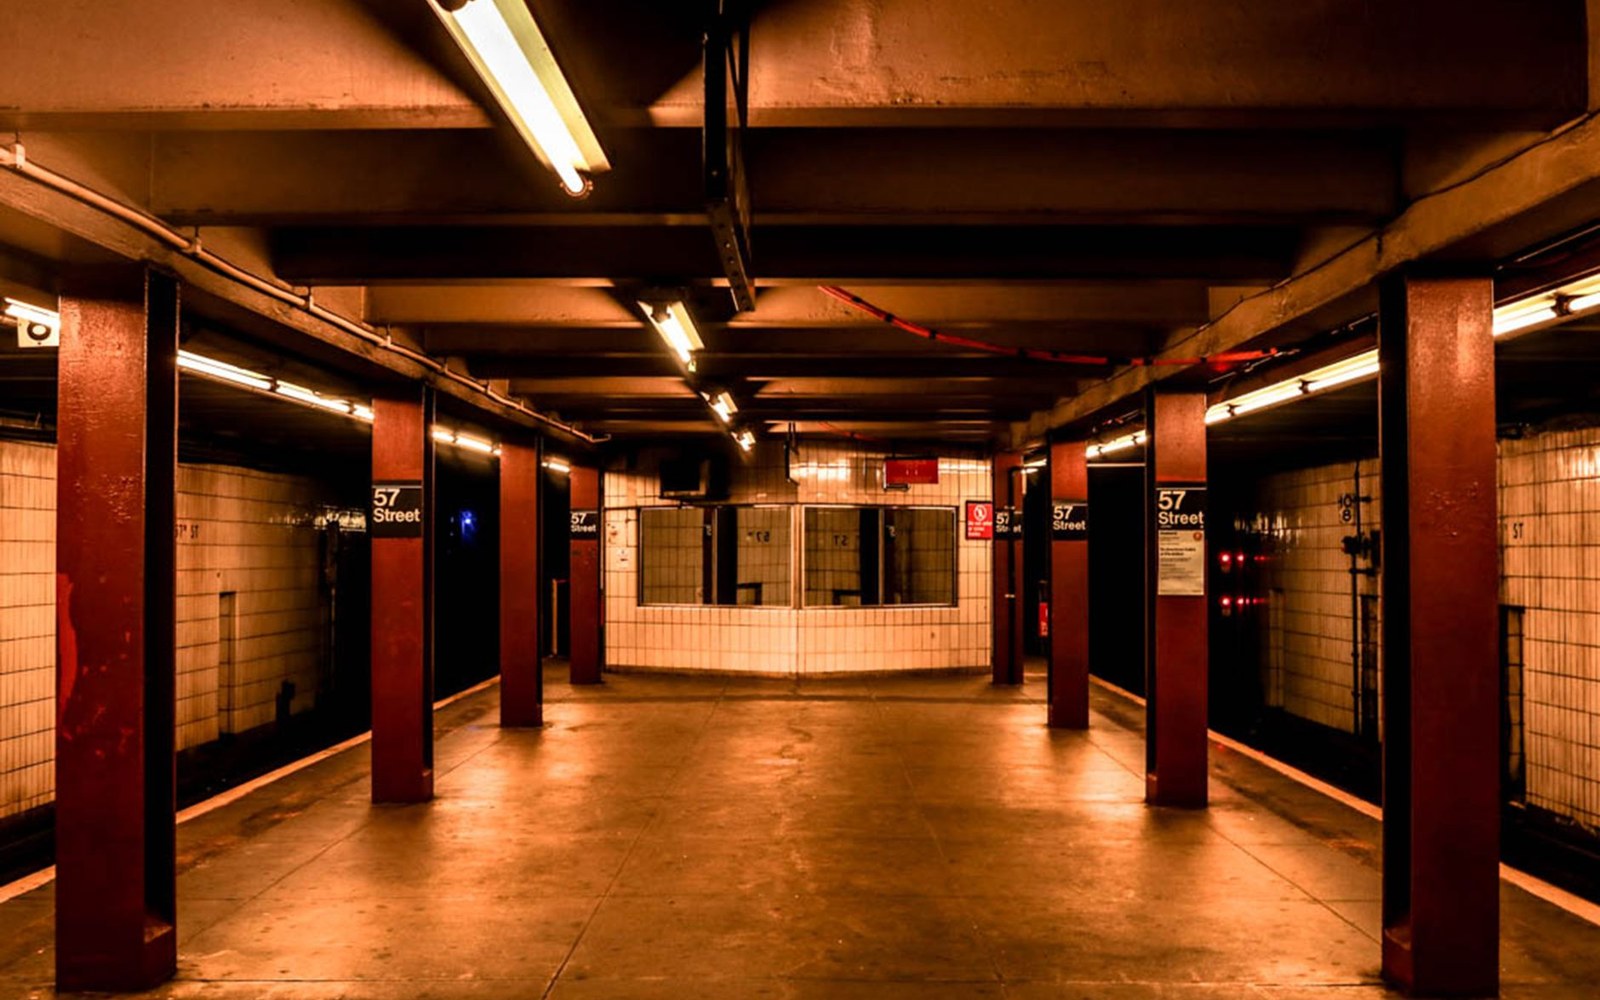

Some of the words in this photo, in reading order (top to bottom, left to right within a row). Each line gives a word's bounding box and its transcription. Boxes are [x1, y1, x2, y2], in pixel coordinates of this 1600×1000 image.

[373, 488, 401, 507] 57
[1158, 490, 1186, 511] 57
[373, 507, 421, 523] Street
[996, 512, 1010, 525] 57
[1053, 505, 1073, 519] 57
[1158, 510, 1204, 525] Street
[570, 513, 587, 525] 57
[1052, 519, 1086, 531] Street
[570, 524, 597, 533] Street
[996, 523, 1022, 533] Stret
